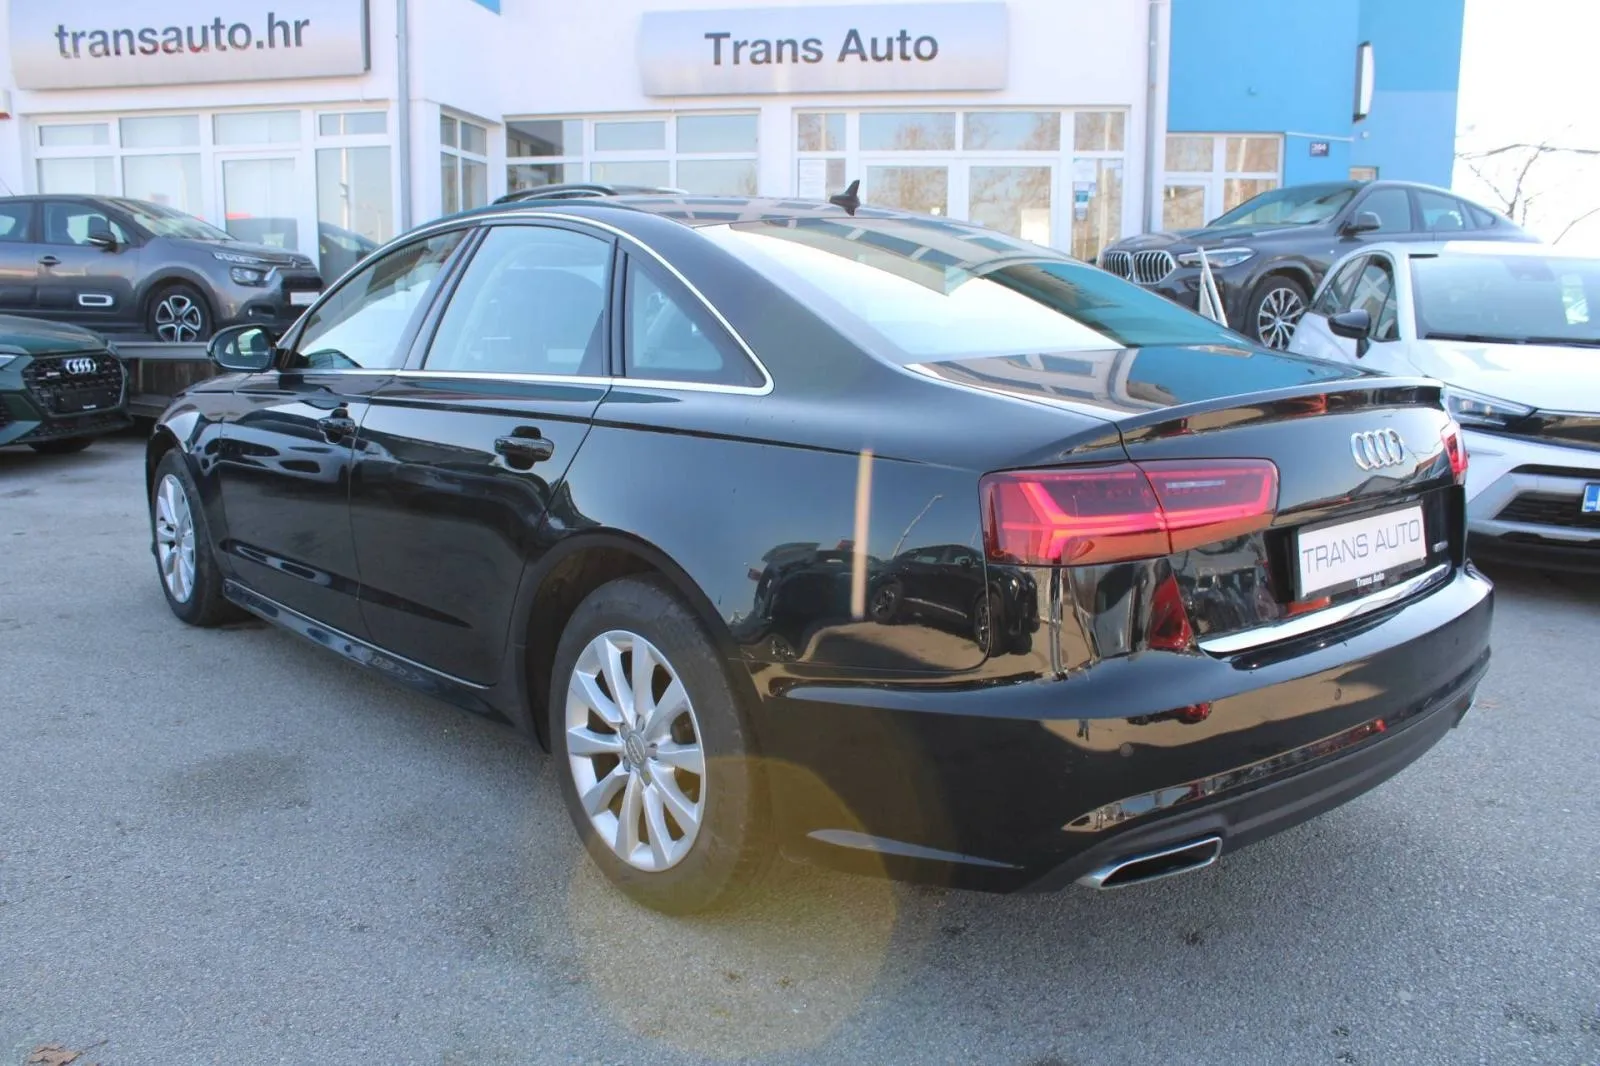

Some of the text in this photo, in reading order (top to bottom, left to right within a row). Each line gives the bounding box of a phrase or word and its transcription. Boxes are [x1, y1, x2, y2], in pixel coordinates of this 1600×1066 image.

[55, 12, 310, 59] transauto.hr
[704, 29, 939, 66] Trans Auto
[1302, 519, 1420, 574] TRANS AUTO
